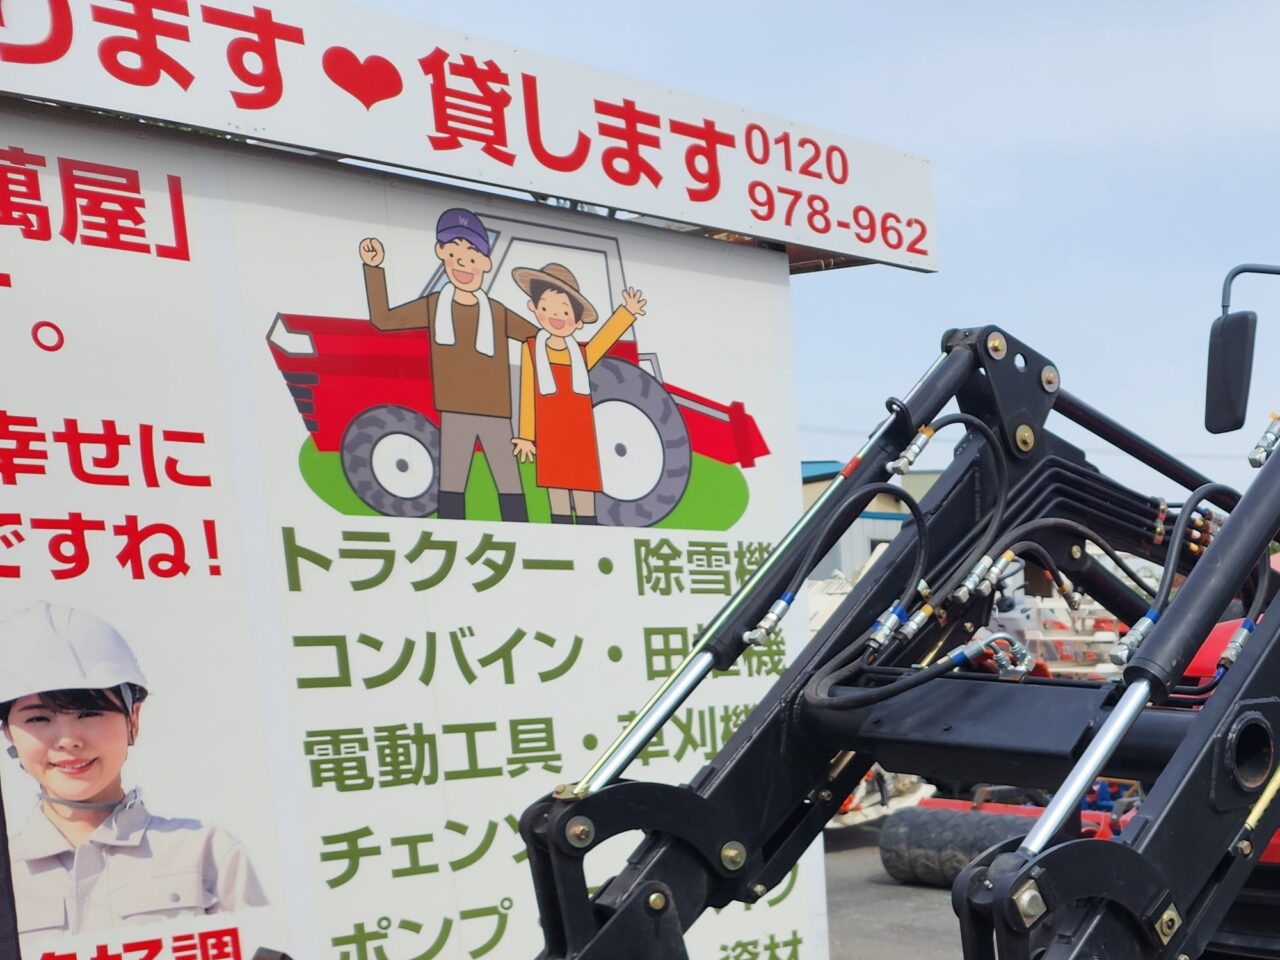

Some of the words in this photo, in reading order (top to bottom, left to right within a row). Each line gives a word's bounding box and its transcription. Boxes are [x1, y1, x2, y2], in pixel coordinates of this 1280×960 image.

[421, 47, 737, 203] 貸します
[745, 123, 849, 185] 0120
[748, 181, 928, 256] 978-962
[0, 410, 213, 488] 幸せに
[293, 623, 786, 690] コンバイン・田機
